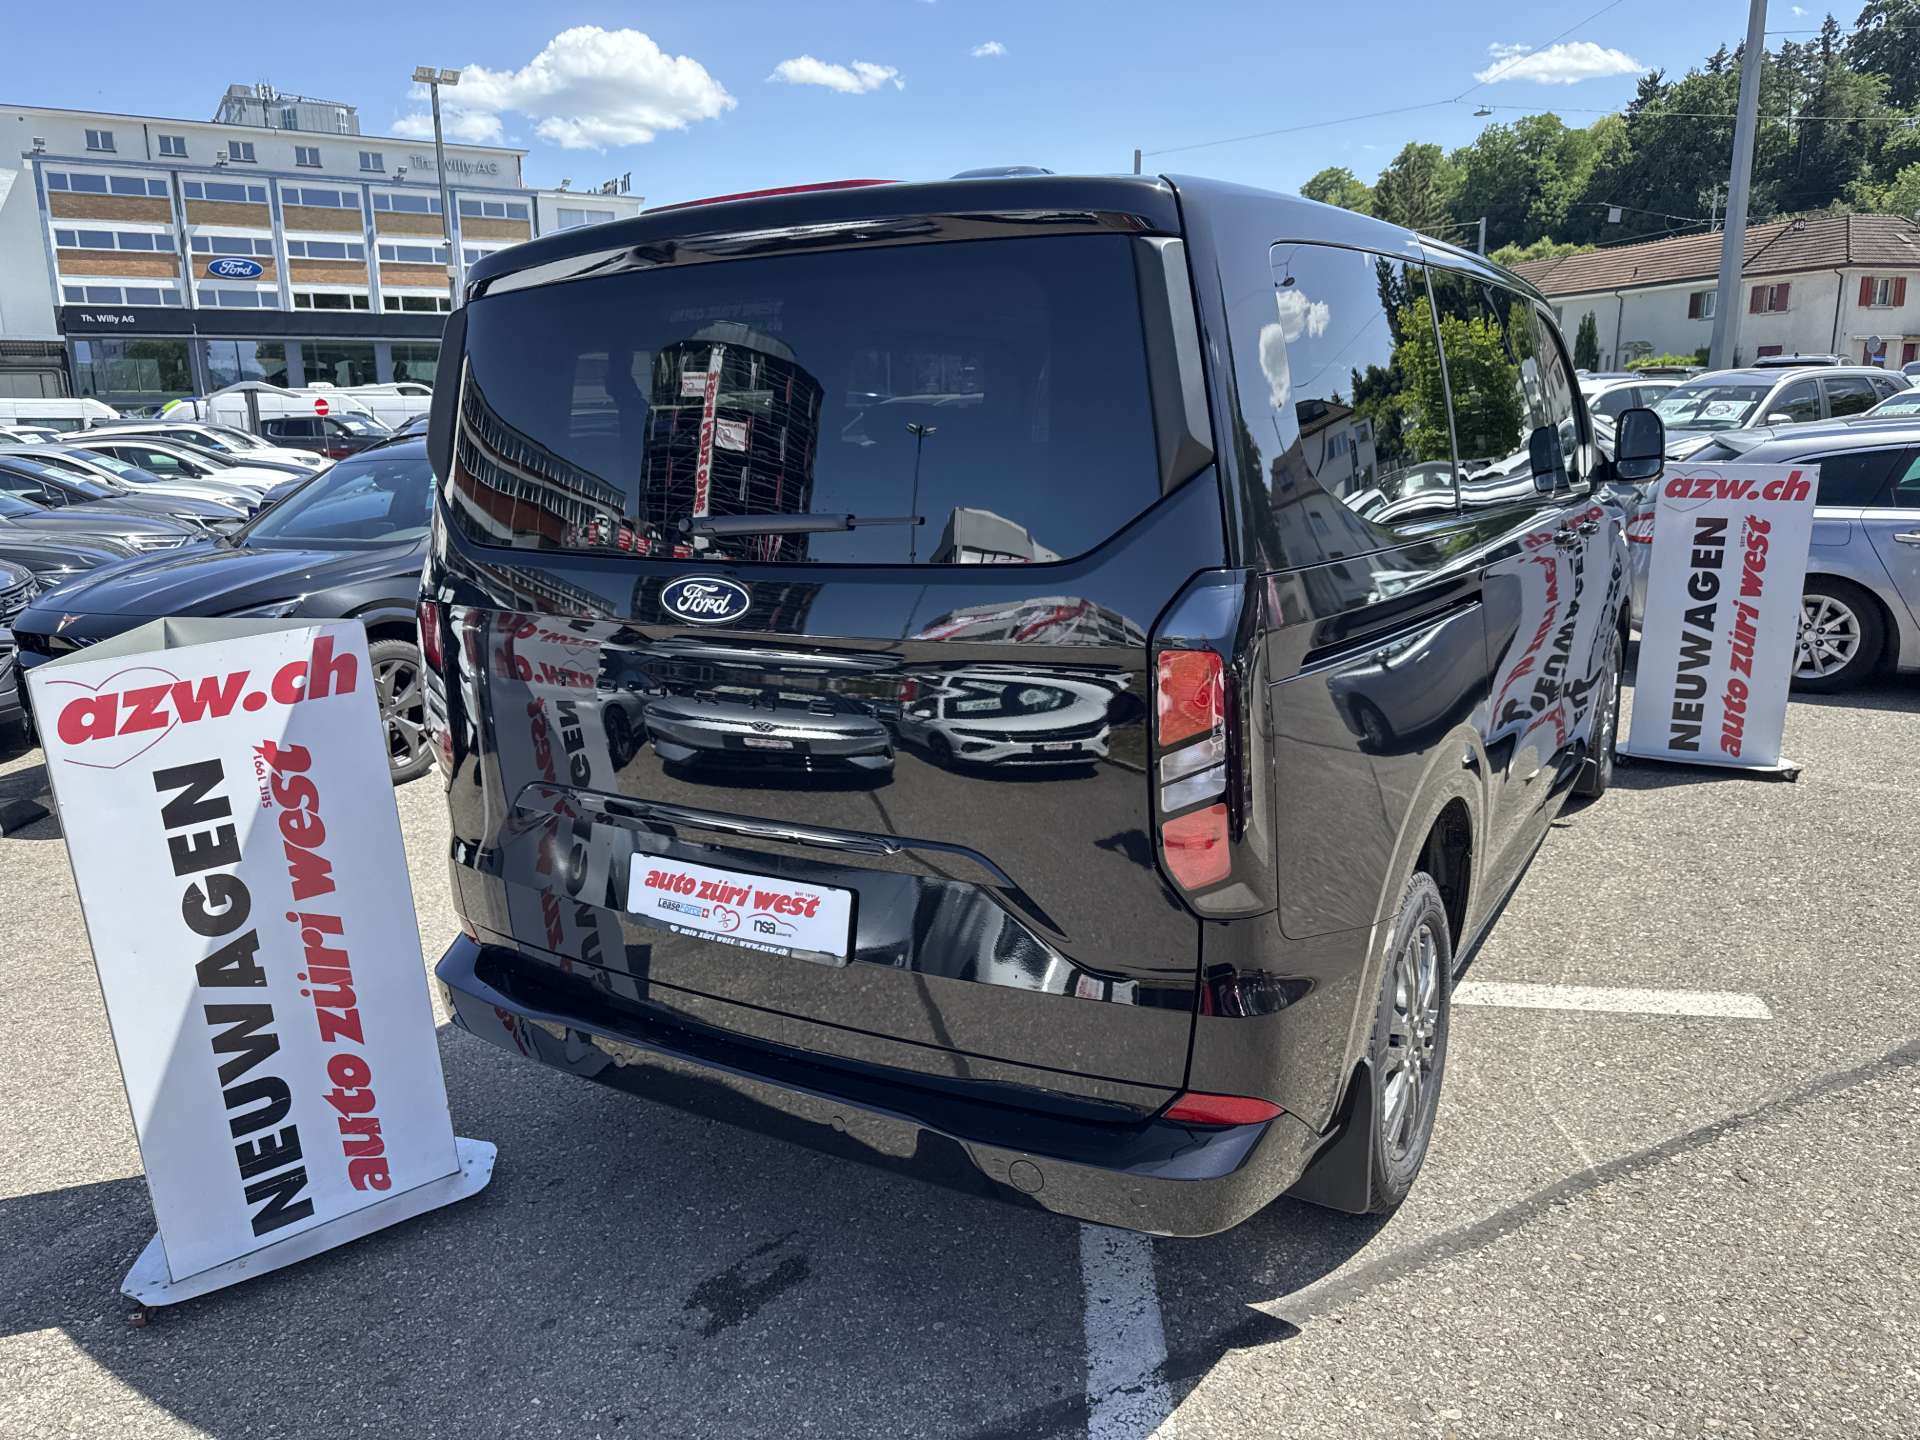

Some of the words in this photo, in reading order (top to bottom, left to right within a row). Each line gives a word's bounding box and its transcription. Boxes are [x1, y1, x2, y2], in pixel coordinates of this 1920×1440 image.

[476, 160, 499, 175] AG
[218, 261, 253, 276] Ford
[80, 314, 95, 322] Th.
[96, 314, 119, 324] Willy
[121, 315, 135, 323] AG
[1664, 470, 1811, 501] azw.ch
[1739, 514, 1772, 597] west
[676, 583, 732, 615] Ford
[1668, 517, 1728, 752] NEUWAGEN
[1727, 600, 1759, 679] züri
[57, 637, 357, 745] azw.ch
[1720, 678, 1748, 758] auto
[253, 754, 267, 781] 1991
[252, 739, 336, 901] west
[260, 786, 273, 809] SEIT
[644, 869, 697, 896] auto
[695, 880, 753, 907] züri
[754, 890, 821, 919] west
[679, 927, 699, 938] auto
[753, 919, 776, 935] nsa
[152, 758, 314, 1237] NEUWAGEN
[285, 911, 364, 1044] züri
[322, 1053, 392, 1192] auto
